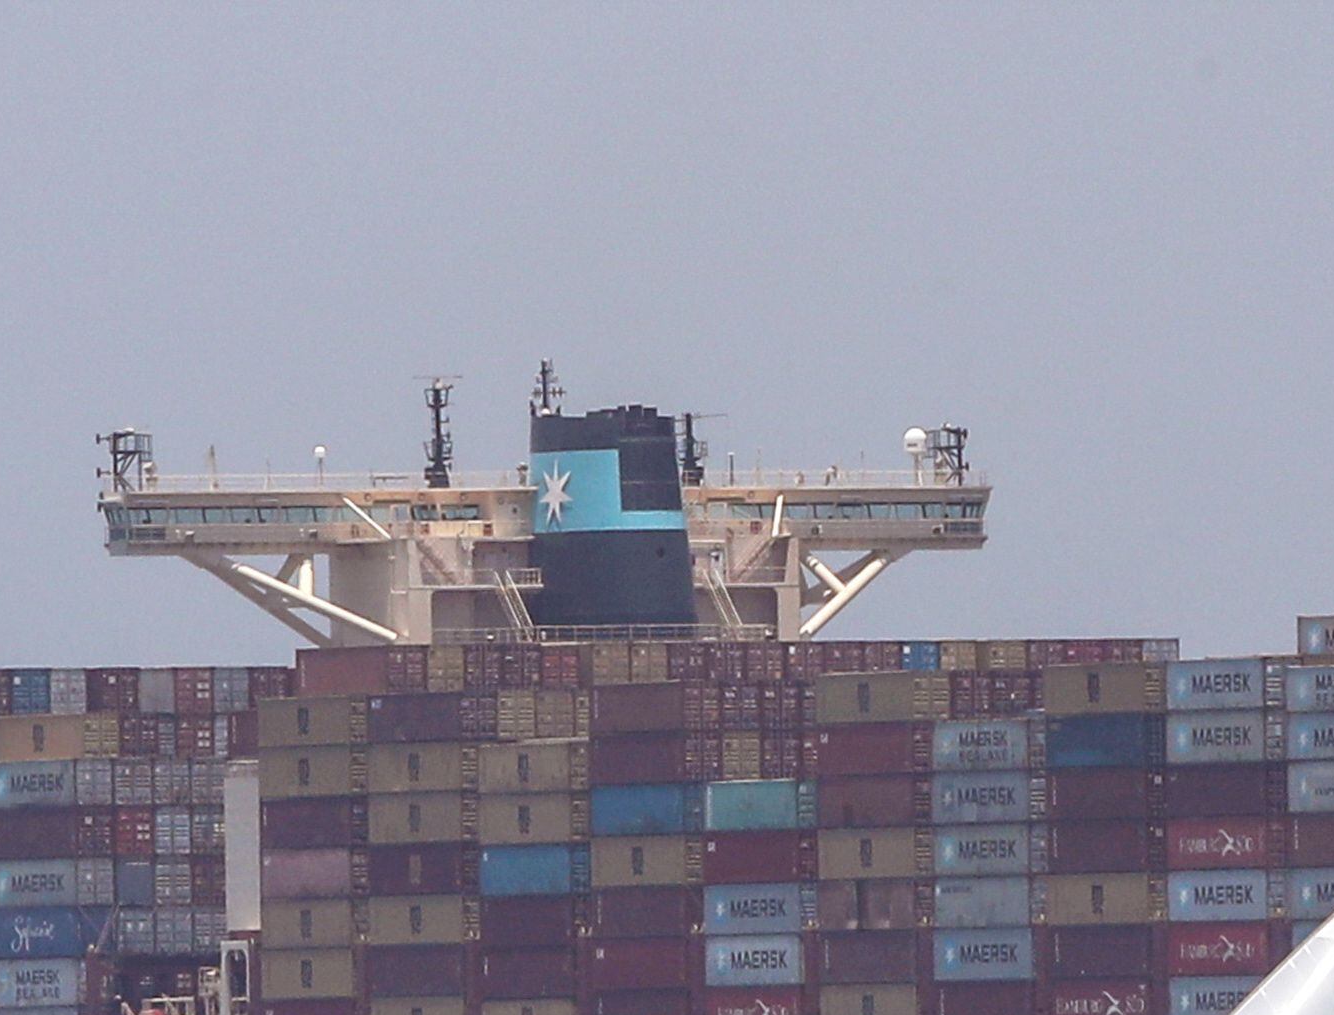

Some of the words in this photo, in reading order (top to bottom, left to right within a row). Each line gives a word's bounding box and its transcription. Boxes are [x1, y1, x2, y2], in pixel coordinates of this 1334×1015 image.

[1191, 673, 1251, 693] MAERSK
[959, 731, 1007, 747] MAERSK
[1192, 728, 1251, 747] MAERSK
[10, 774, 63, 793] MAERSK
[958, 787, 1015, 805] MAERSK
[959, 841, 1016, 858] MAERSK
[11, 873, 64, 891] MAERSK
[1195, 886, 1253, 905] MAERSK
[730, 901, 786, 917] MAERSK
[730, 951, 787, 969] MAERSK
[960, 945, 1018, 964] MAERSK
[16, 970, 60, 984] MAERSK
